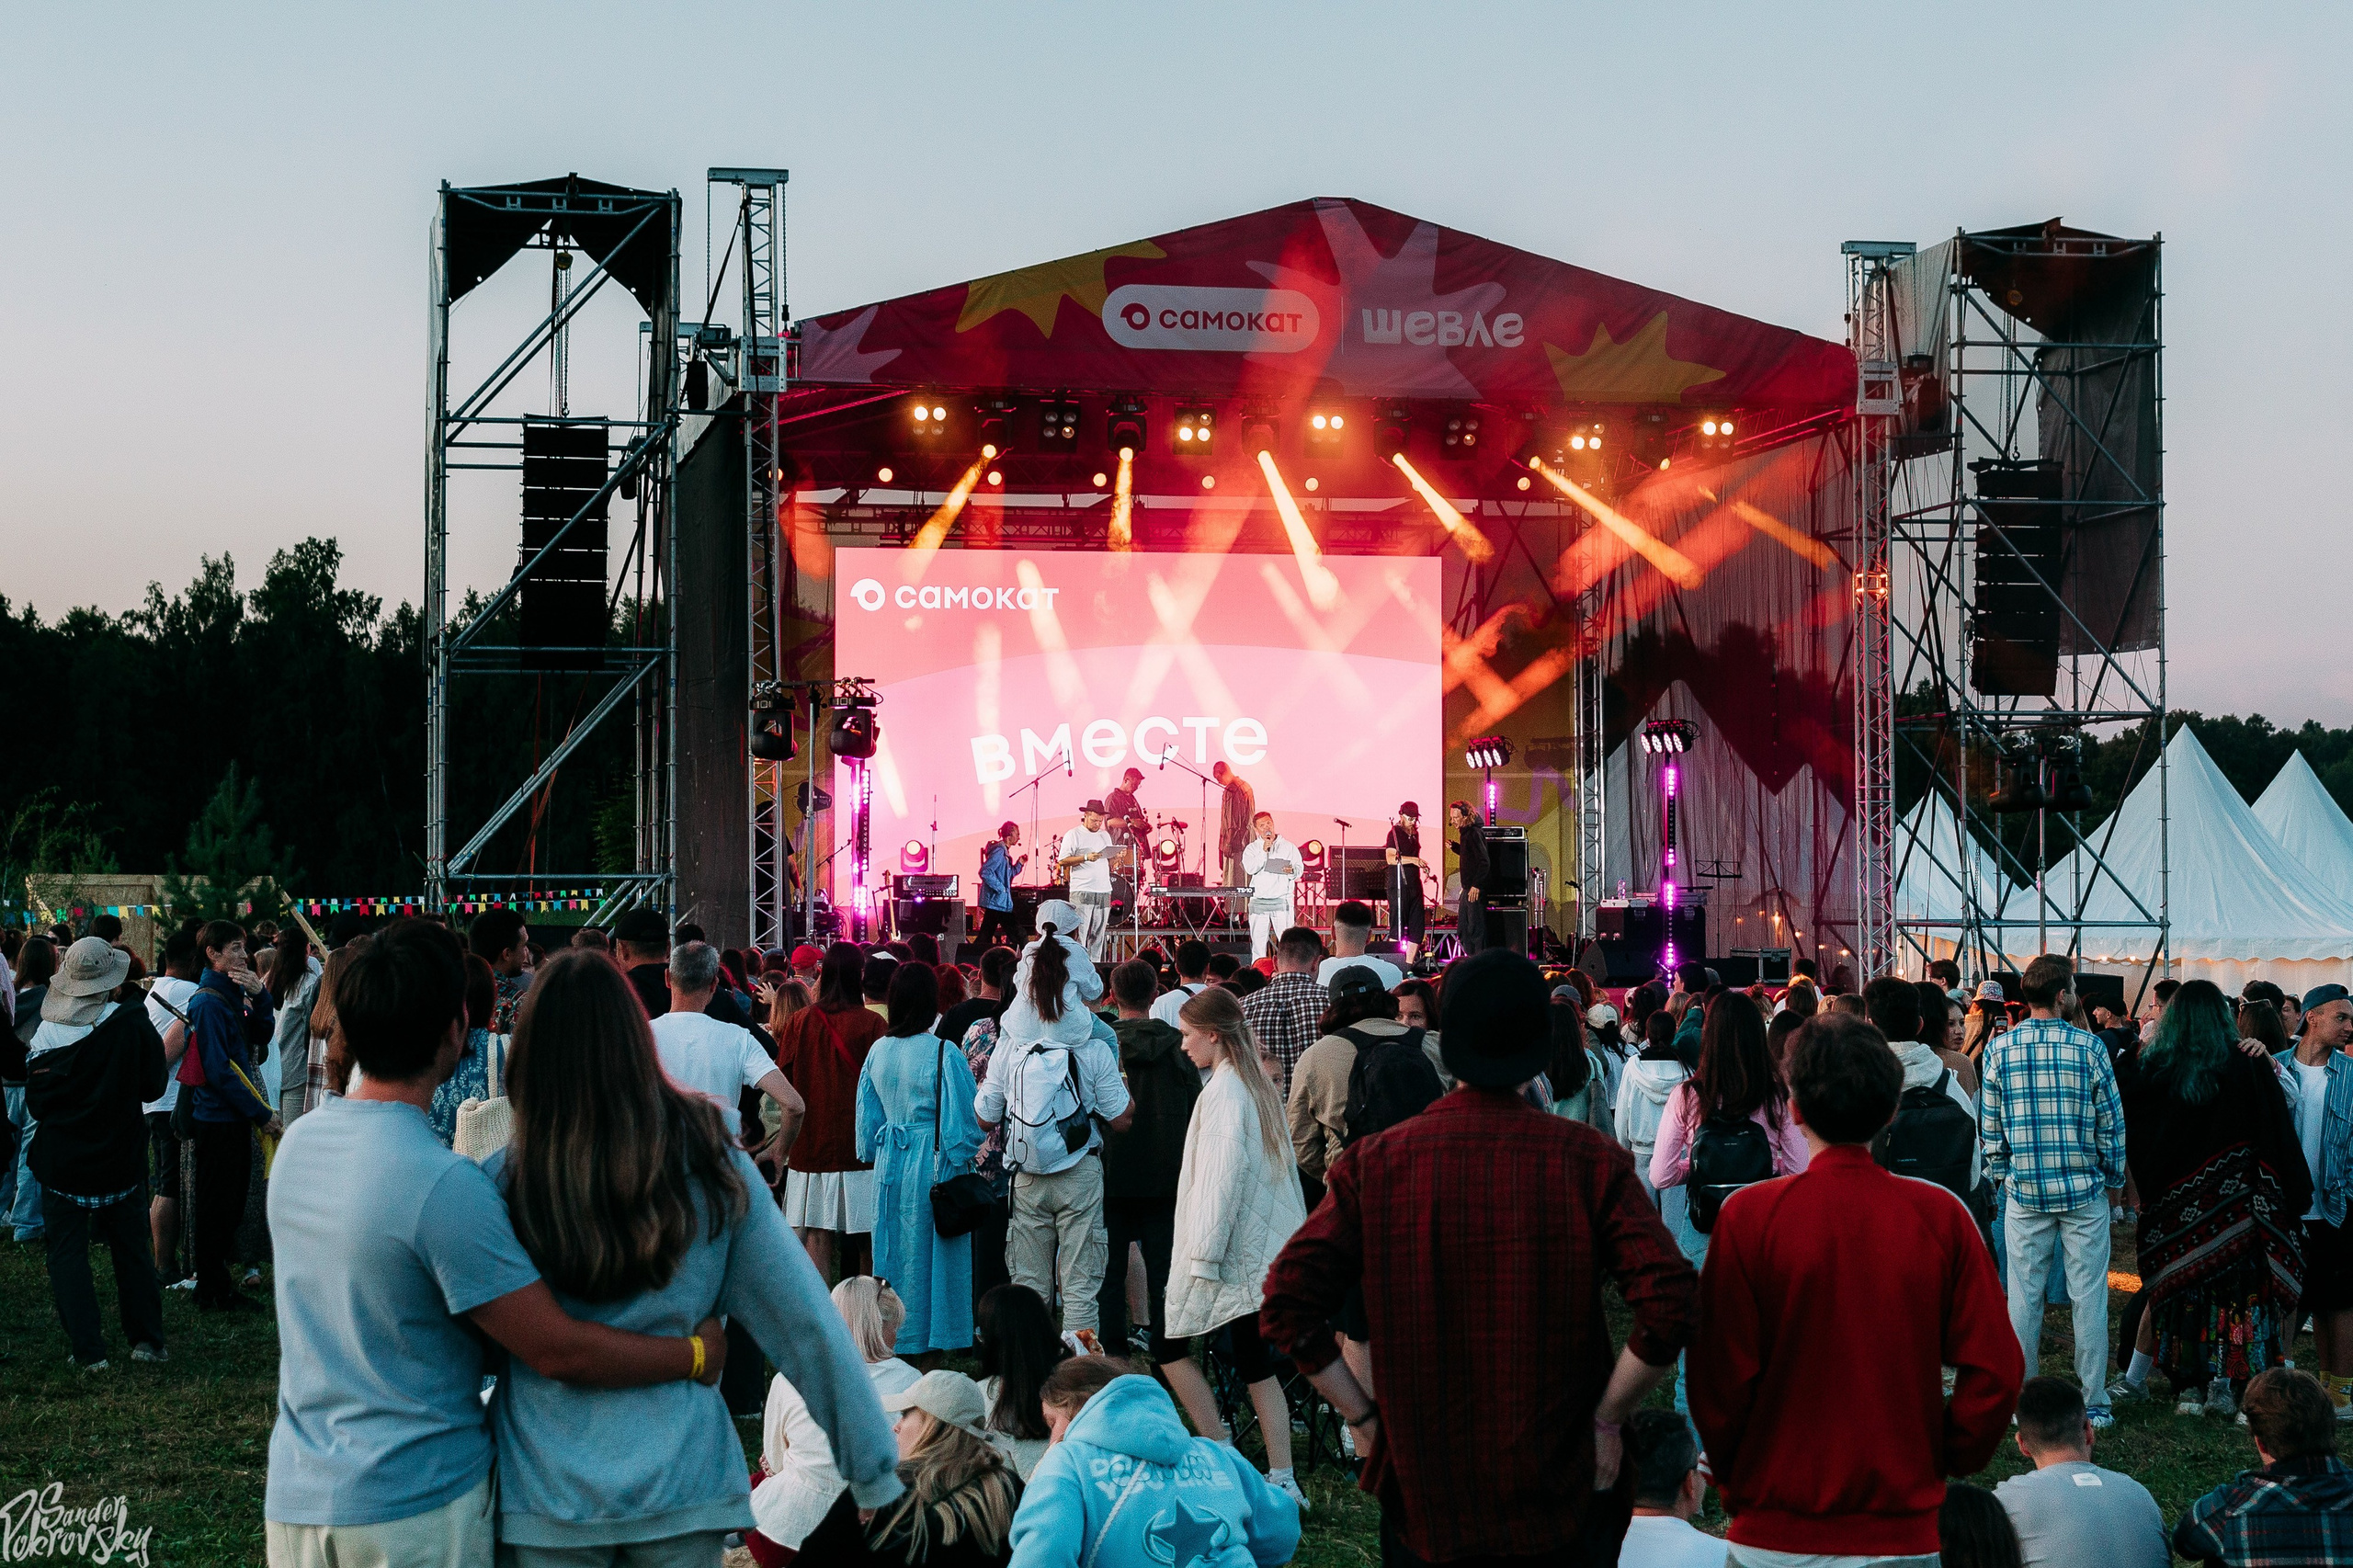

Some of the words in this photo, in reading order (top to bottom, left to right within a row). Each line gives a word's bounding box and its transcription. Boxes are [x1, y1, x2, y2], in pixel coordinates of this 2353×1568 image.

[1158, 307, 1303, 333] самокат
[894, 585, 1060, 610] самокат
[970, 716, 1268, 785] вместе
